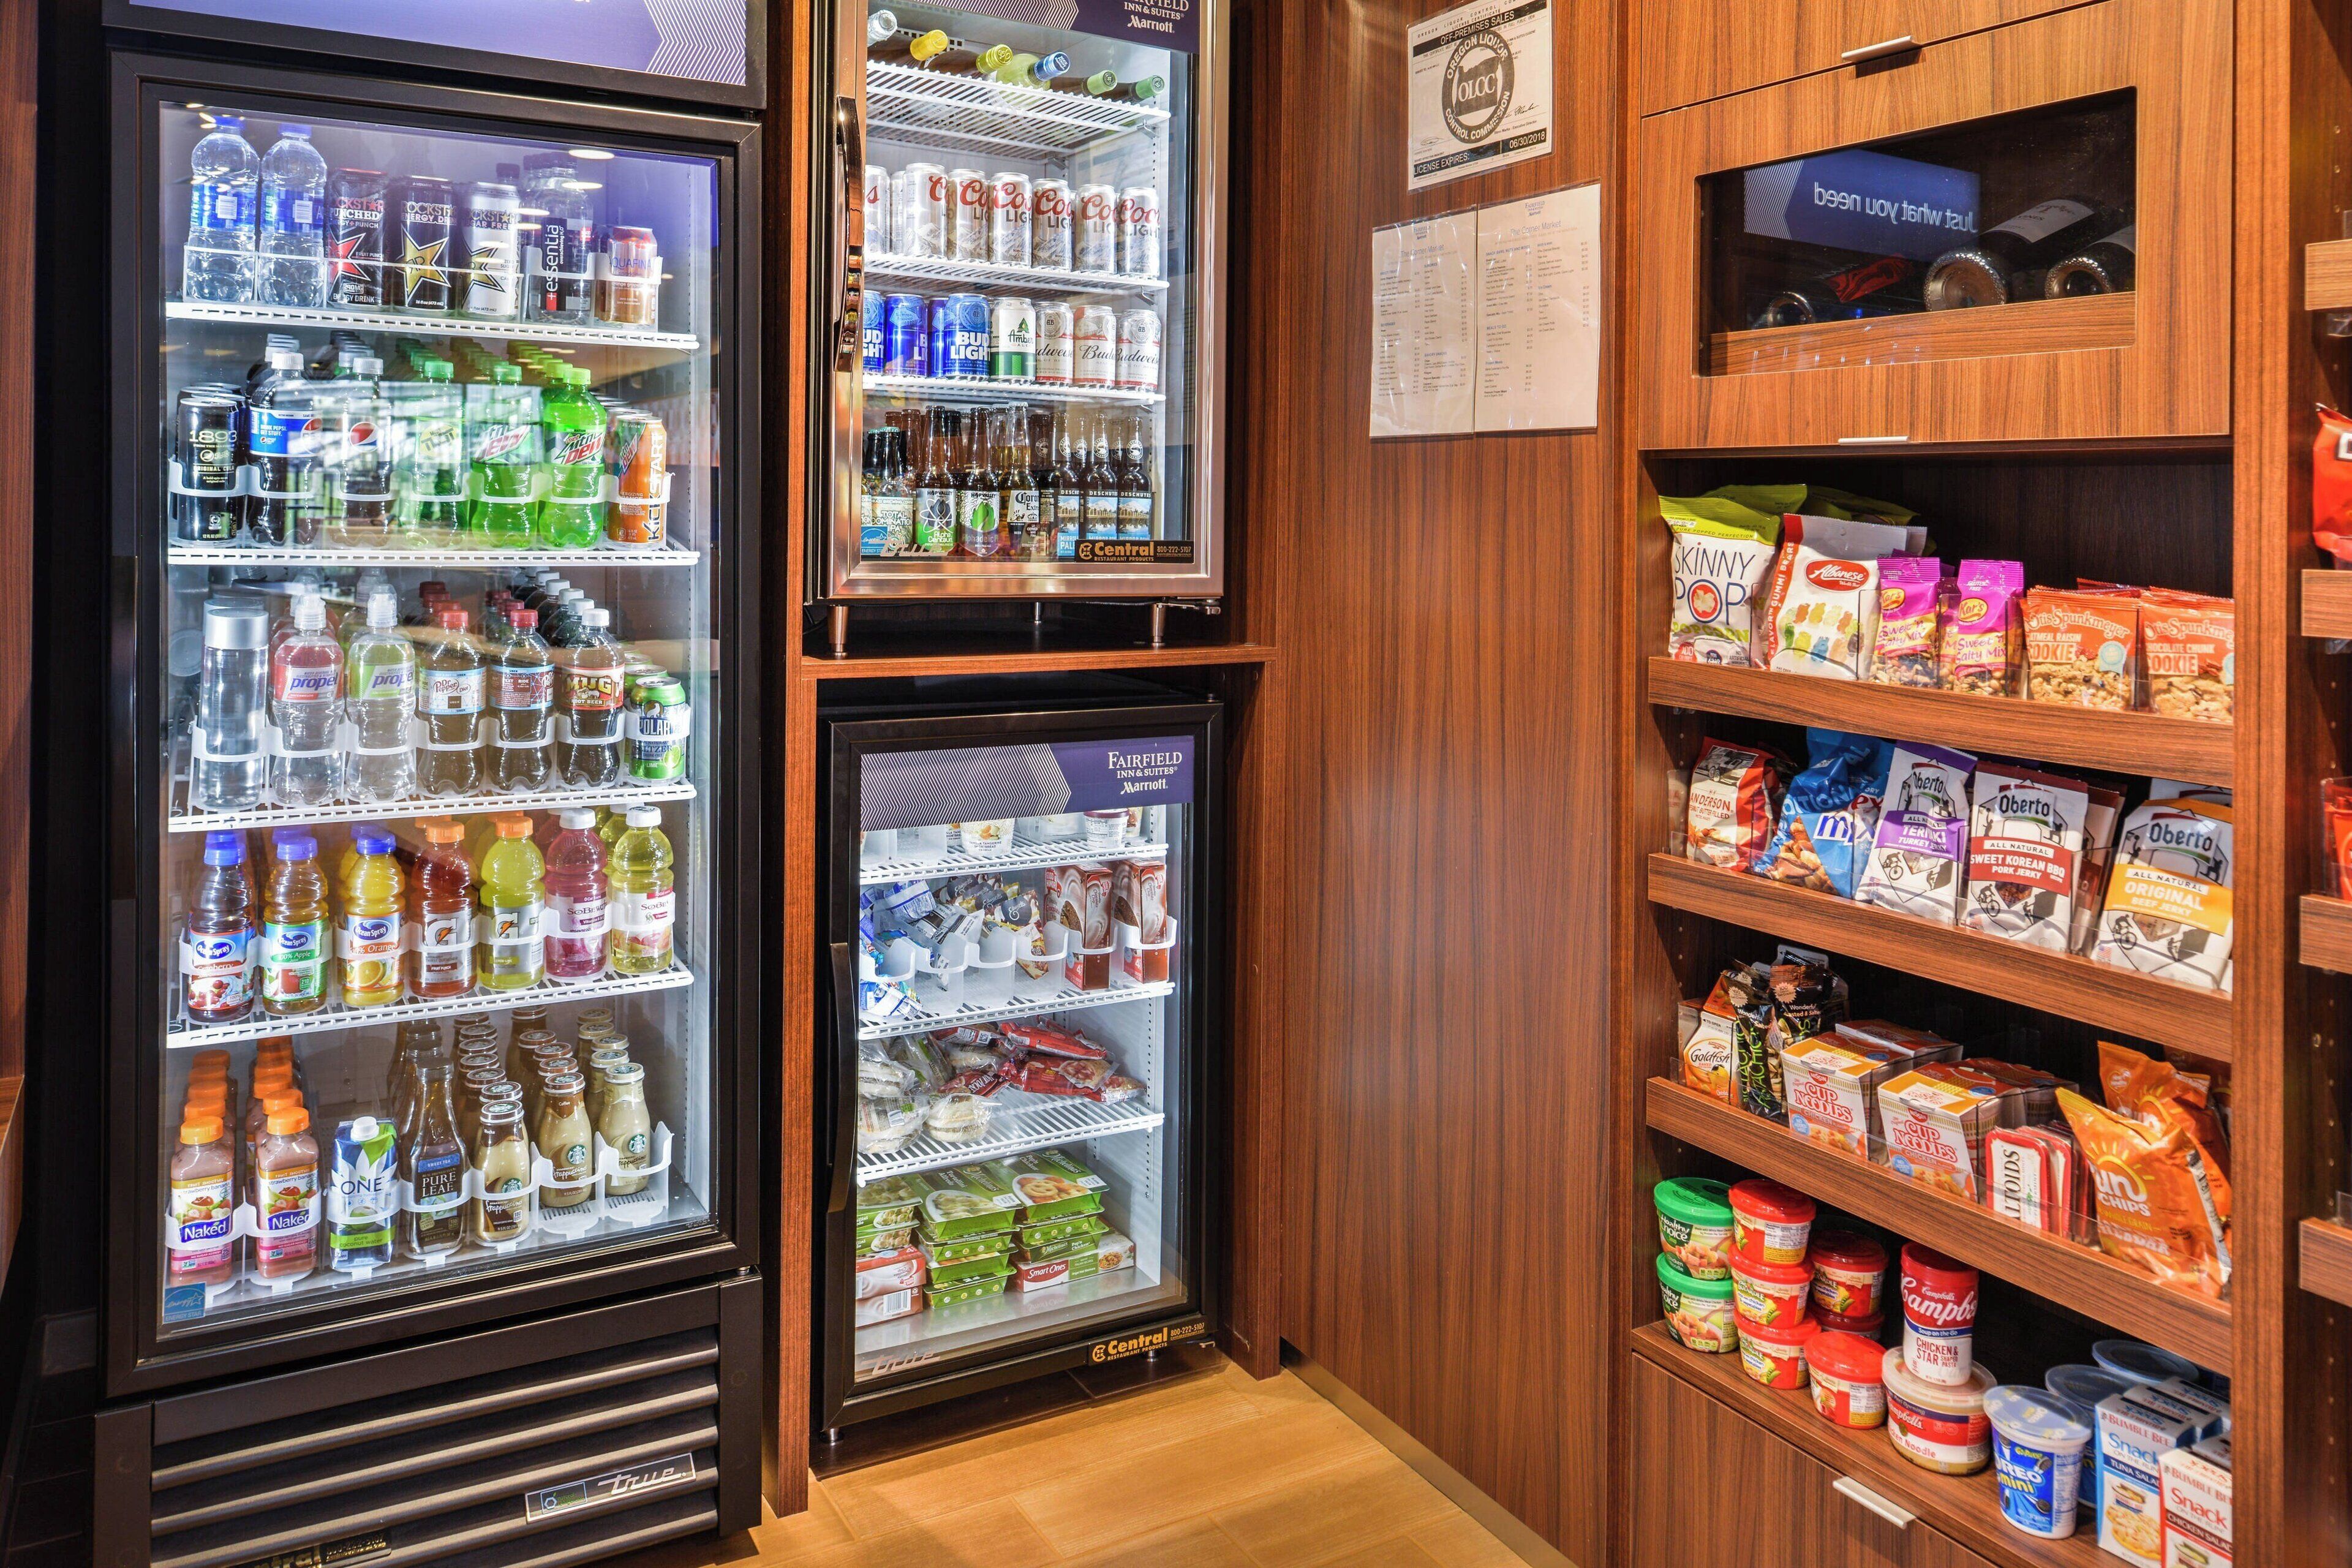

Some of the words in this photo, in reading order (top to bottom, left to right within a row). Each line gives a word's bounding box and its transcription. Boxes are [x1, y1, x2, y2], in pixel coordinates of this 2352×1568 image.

[1124, 2, 1142, 12] INN
[1142, 5, 1150, 13] &
[1127, 15, 1175, 33] Marriott
[1417, 27, 1438, 38] OREGON
[1444, 17, 1463, 28] LIQUOR
[1470, 5, 1496, 17] CONTROL
[1441, 22, 1490, 45] OFF-PREMISES
[1491, 10, 1515, 26] SALES
[1452, 20, 1469, 30] LICENSE
[1471, 9, 1501, 23] CERTIFICATE
[1447, 33, 1477, 80] OREGON
[1479, 33, 1509, 62] LIQUOR
[1458, 73, 1495, 102] OLCC
[1445, 108, 1469, 140] CONTROL
[1471, 91, 1510, 140] COMMISSION
[1509, 132, 1546, 149] 06/30/2018
[1414, 160, 1440, 175] LICENSE
[1441, 153, 1470, 168] EXPIRES:
[1541, 220, 1562, 230] Market
[545, 224, 560, 294] essentia
[958, 331, 990, 345] BUD
[1008, 330, 1034, 346] Amber
[950, 345, 991, 361] LIGHT
[189, 430, 238, 443] 1893
[933, 531, 953, 540] Alpha
[1692, 528, 1716, 537] POPPED
[1094, 541, 1155, 557] Central
[1675, 541, 1757, 580] SKINNY
[1771, 573, 1786, 607] GUMMI
[1781, 541, 1795, 572] BEARS
[1808, 564, 1866, 582] Albanese
[1674, 576, 1748, 625] POP
[1959, 601, 1985, 613] Kar's
[2051, 608, 2131, 639] Spunkmeyer
[1958, 637, 1989, 651] Sweet
[2056, 633, 2082, 643] RAISIN
[1956, 649, 1982, 663] Salty
[1985, 646, 2007, 658] Mix
[2186, 644, 2216, 654] CHUNK
[289, 671, 339, 691] propel
[432, 682, 458, 695] Pepper
[565, 676, 612, 695] MUG
[639, 718, 671, 736] POLAR
[1108, 751, 1183, 769] FAIRFIELD
[1117, 769, 1135, 778] INN
[1136, 769, 1144, 777] &
[1912, 770, 1944, 794] Oberto
[1120, 777, 1168, 796] Marriott
[1690, 793, 1732, 812] ANDERSON
[1999, 793, 2050, 815] Oberto
[1898, 837, 1929, 848] TURKEY
[2149, 821, 2213, 851] Oberto
[2010, 843, 2049, 856] NATURAL
[1970, 853, 2003, 865] SWEET
[2004, 856, 2046, 872] KOREAN
[2046, 862, 2066, 878] BBQ
[1992, 865, 2015, 875] PORK
[2015, 867, 2043, 880] JERKY
[2156, 874, 2203, 892] NATURAL
[2124, 880, 2204, 911] ORIGINAL
[2130, 896, 2156, 908] BEEF
[2157, 902, 2192, 917] JERKY
[355, 928, 371, 938] Ocean
[371, 925, 386, 937] Spray
[211, 944, 230, 958] Spray
[278, 937, 293, 947] Ocean
[293, 935, 306, 948] Spray
[293, 951, 311, 959] Apple
[1690, 1048, 1731, 1065] Goldfish
[1804, 1082, 1839, 1102] CUP
[1795, 1089, 1853, 1123] NOODLES
[1904, 1120, 1940, 1141] CUP
[1893, 1128, 1958, 1163] NOODLES
[1050, 1153, 1082, 1174] Michelina's
[1904, 1150, 1937, 1165] CHICKEN
[341, 1177, 383, 1196] ONE
[421, 1172, 456, 1188] PURE
[970, 1170, 1000, 1192] Michelina's
[2098, 1193, 2152, 1218] CHIPS
[184, 1221, 227, 1242] Naked
[1660, 1214, 1691, 1235] Healthy
[1046, 1241, 1069, 1255] Michelina's
[1027, 1268, 1047, 1280] Smart
[1046, 1262, 1066, 1275] Ones
[165, 1313, 187, 1322] ENERGY
[1107, 1327, 1168, 1354] Central
[1170, 1322, 1205, 1337] 800-222-5107
[1918, 1327, 1932, 1336] Soup
[1107, 1347, 1141, 1361] RESTAURANT
[1141, 1341, 1168, 1353] PRODUCTS
[1916, 1336, 1953, 1356] CHICKEN
[1953, 1346, 1959, 1356] &
[1917, 1348, 1939, 1366] STAR
[2108, 1414, 2150, 1439] BUMBLE
[2151, 1431, 2171, 1447] BEE
[1904, 1436, 1937, 1458] Noodle
[2110, 1459, 2131, 1477] TUNA
[2124, 1453, 2139, 1464] THE
[2000, 1473, 2034, 1494] mini
[2172, 1466, 2212, 1495] BUMBLE
[2170, 1487, 2228, 1529] Snack
[2167, 1513, 2204, 1539] CHICKEN
